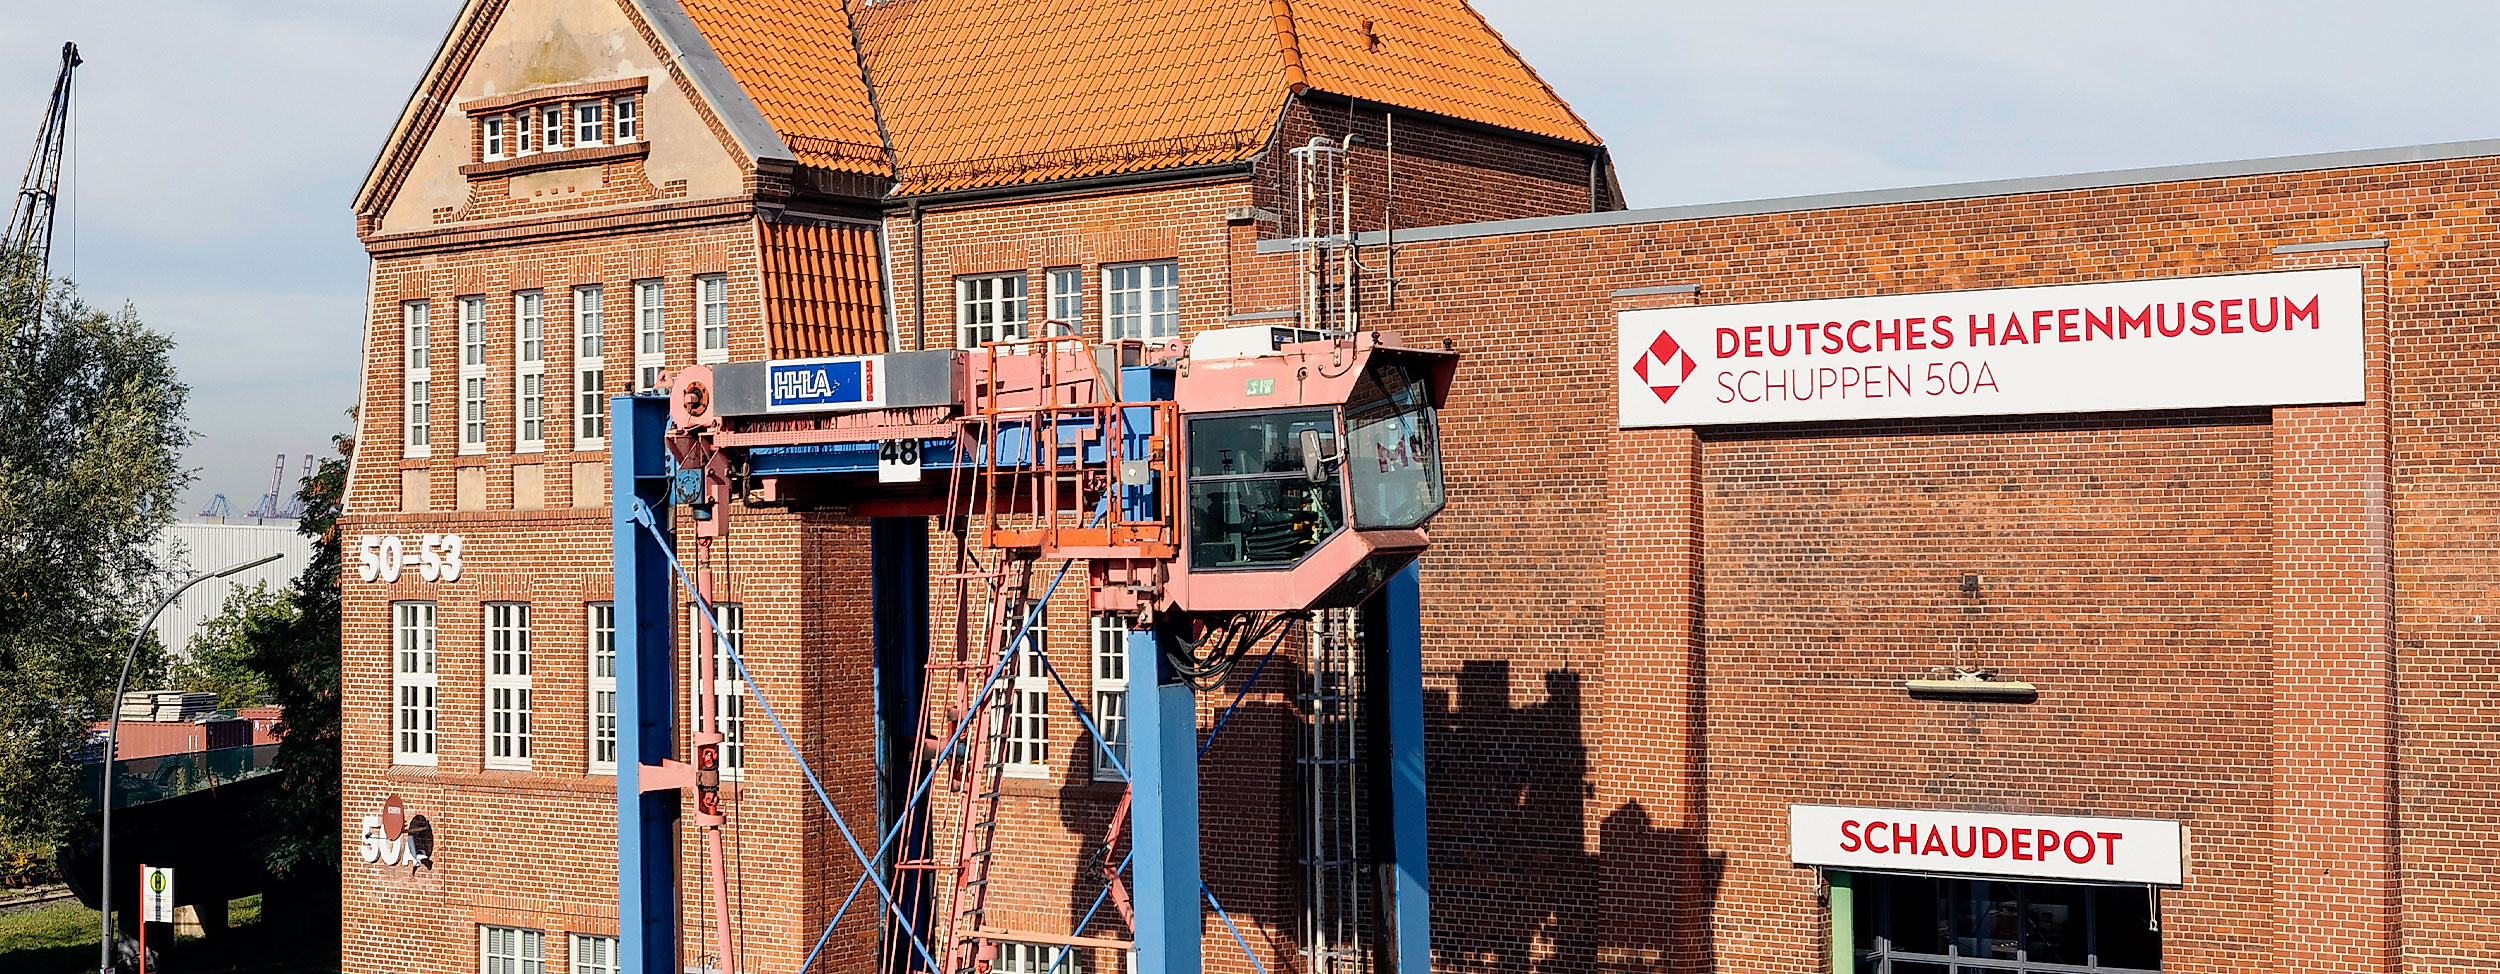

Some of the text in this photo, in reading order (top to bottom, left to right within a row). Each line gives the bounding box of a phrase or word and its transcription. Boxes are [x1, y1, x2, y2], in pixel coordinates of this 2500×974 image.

[1716, 293, 2320, 359] DEUTSCHES HAFENMUSEUM
[774, 369, 832, 399] HHLA
[1716, 361, 1999, 403] SCHUPPEN 50A
[880, 438, 918, 465] 48
[360, 534, 463, 583] 50-53
[1840, 820, 2122, 865] SCHAUDEPOT
